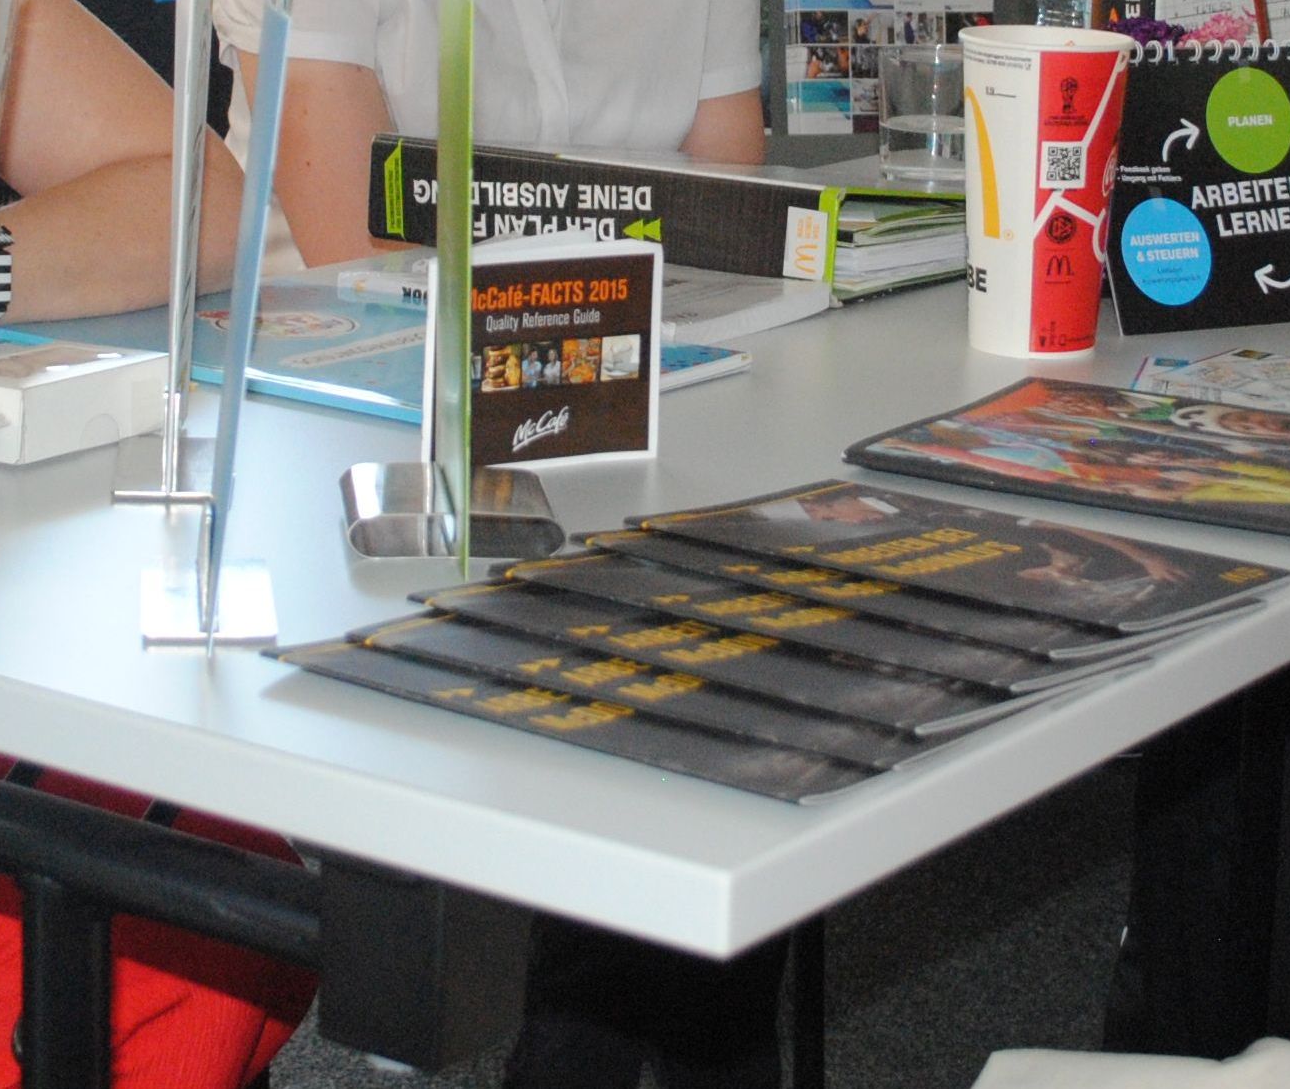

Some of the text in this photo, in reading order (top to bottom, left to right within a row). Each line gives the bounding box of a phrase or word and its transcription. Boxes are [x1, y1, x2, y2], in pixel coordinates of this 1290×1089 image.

[1227, 113, 1273, 128] PLANEN
[577, 184, 653, 211] DEINE
[1130, 231, 1201, 246] AUSWERTEN
[1147, 248, 1200, 262] STEUERN
[588, 278, 629, 302] 2015
[485, 307, 601, 333] Quality Reference Guide
[512, 405, 570, 451] McCafé
